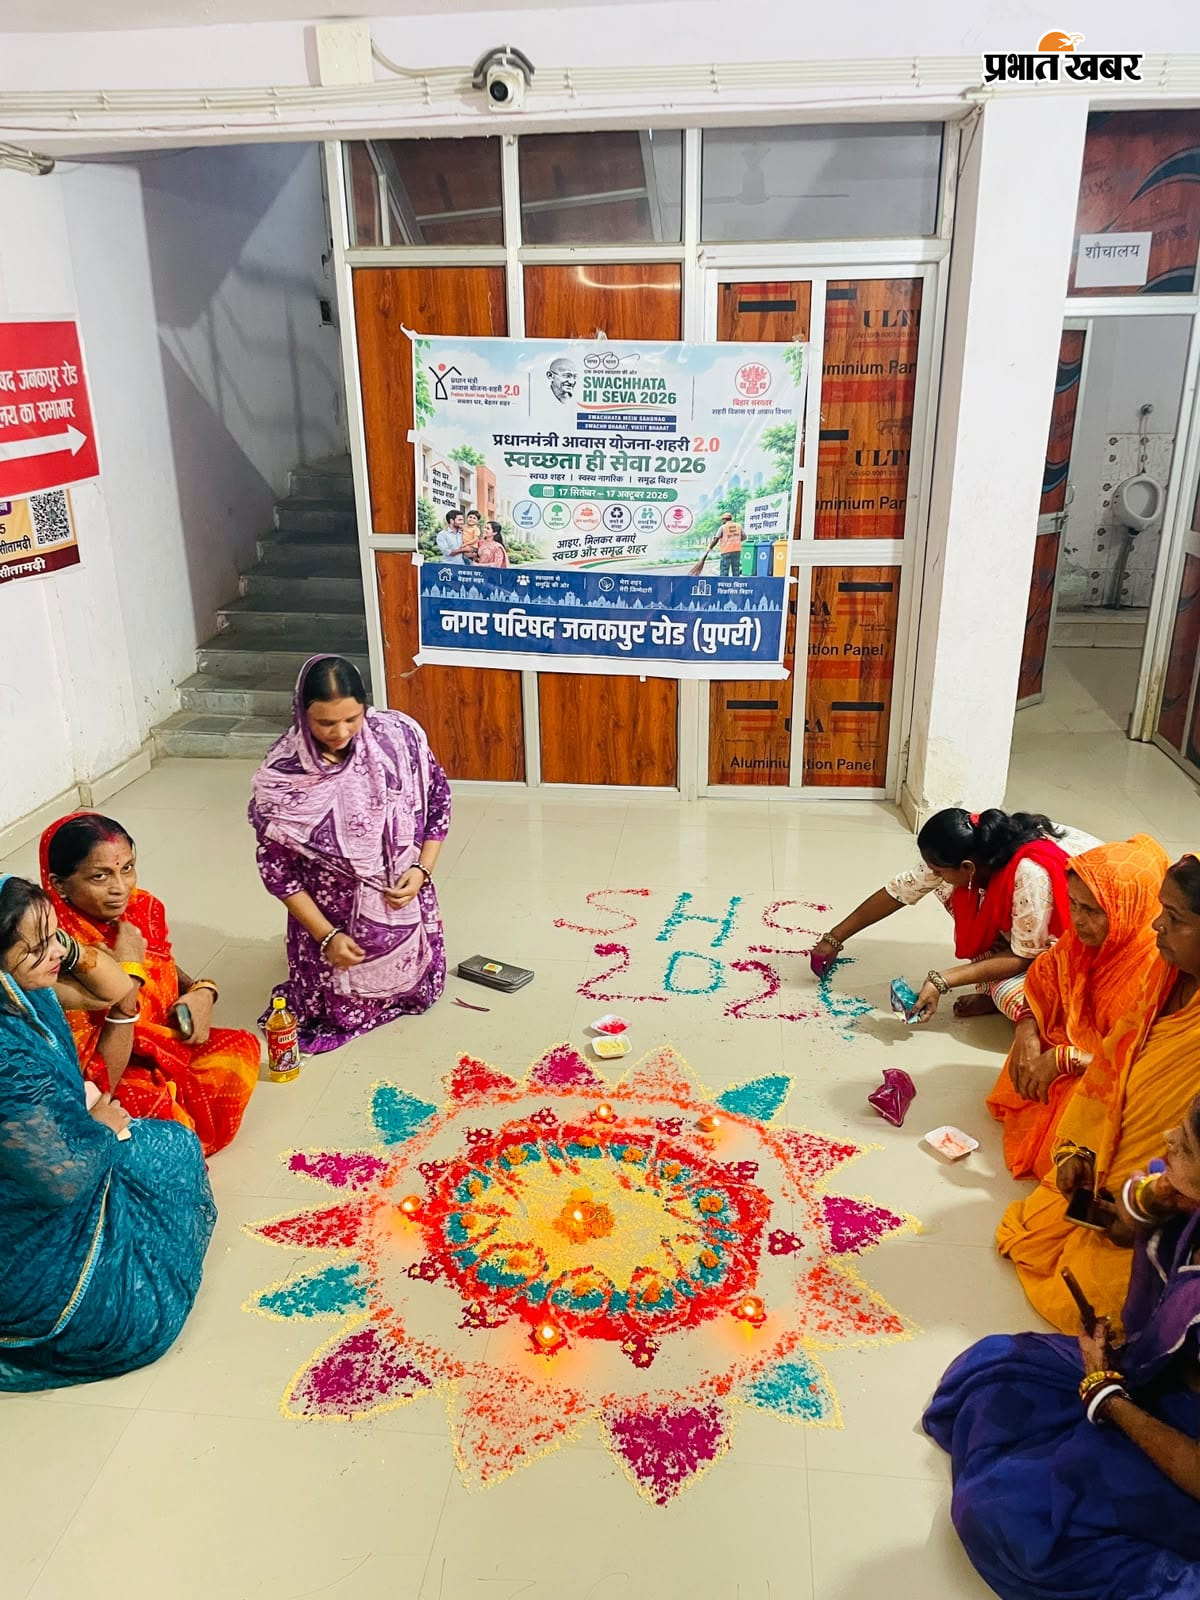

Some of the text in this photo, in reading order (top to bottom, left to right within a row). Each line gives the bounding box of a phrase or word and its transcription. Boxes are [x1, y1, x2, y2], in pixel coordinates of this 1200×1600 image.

[1085, 241, 1140, 259] शौचालय
[822, 361, 884, 375] minium
[16, 367, 61, 393] जनकपुर
[60, 360, 79, 386] रोड
[583, 376, 666, 390] SWACHHATA
[504, 384, 520, 396] 2.0
[583, 390, 677, 404] HI SEVA 2026
[19, 404, 36, 423] का
[492, 432, 720, 452] प्रधानमंत्री आवास योजना-शहरी 2.0
[504, 449, 706, 473] स्वच्छता ही सेवा 2026
[550, 473, 566, 481] शहर
[597, 474, 624, 483] नागरिक
[658, 476, 678, 484] बिहार
[558, 488, 567, 496] 17
[646, 491, 668, 499] 2026
[816, 497, 875, 510] minium
[557, 533, 636, 549] आइए, मिलकर बनाएं
[552, 545, 648, 561] स्वच्छ और समृद्ध शहर
[439, 608, 762, 654] नगर परिषद जनकपुर रोड (पुपरी)
[844, 643, 883, 656] Panel
[837, 758, 876, 770] Panel
